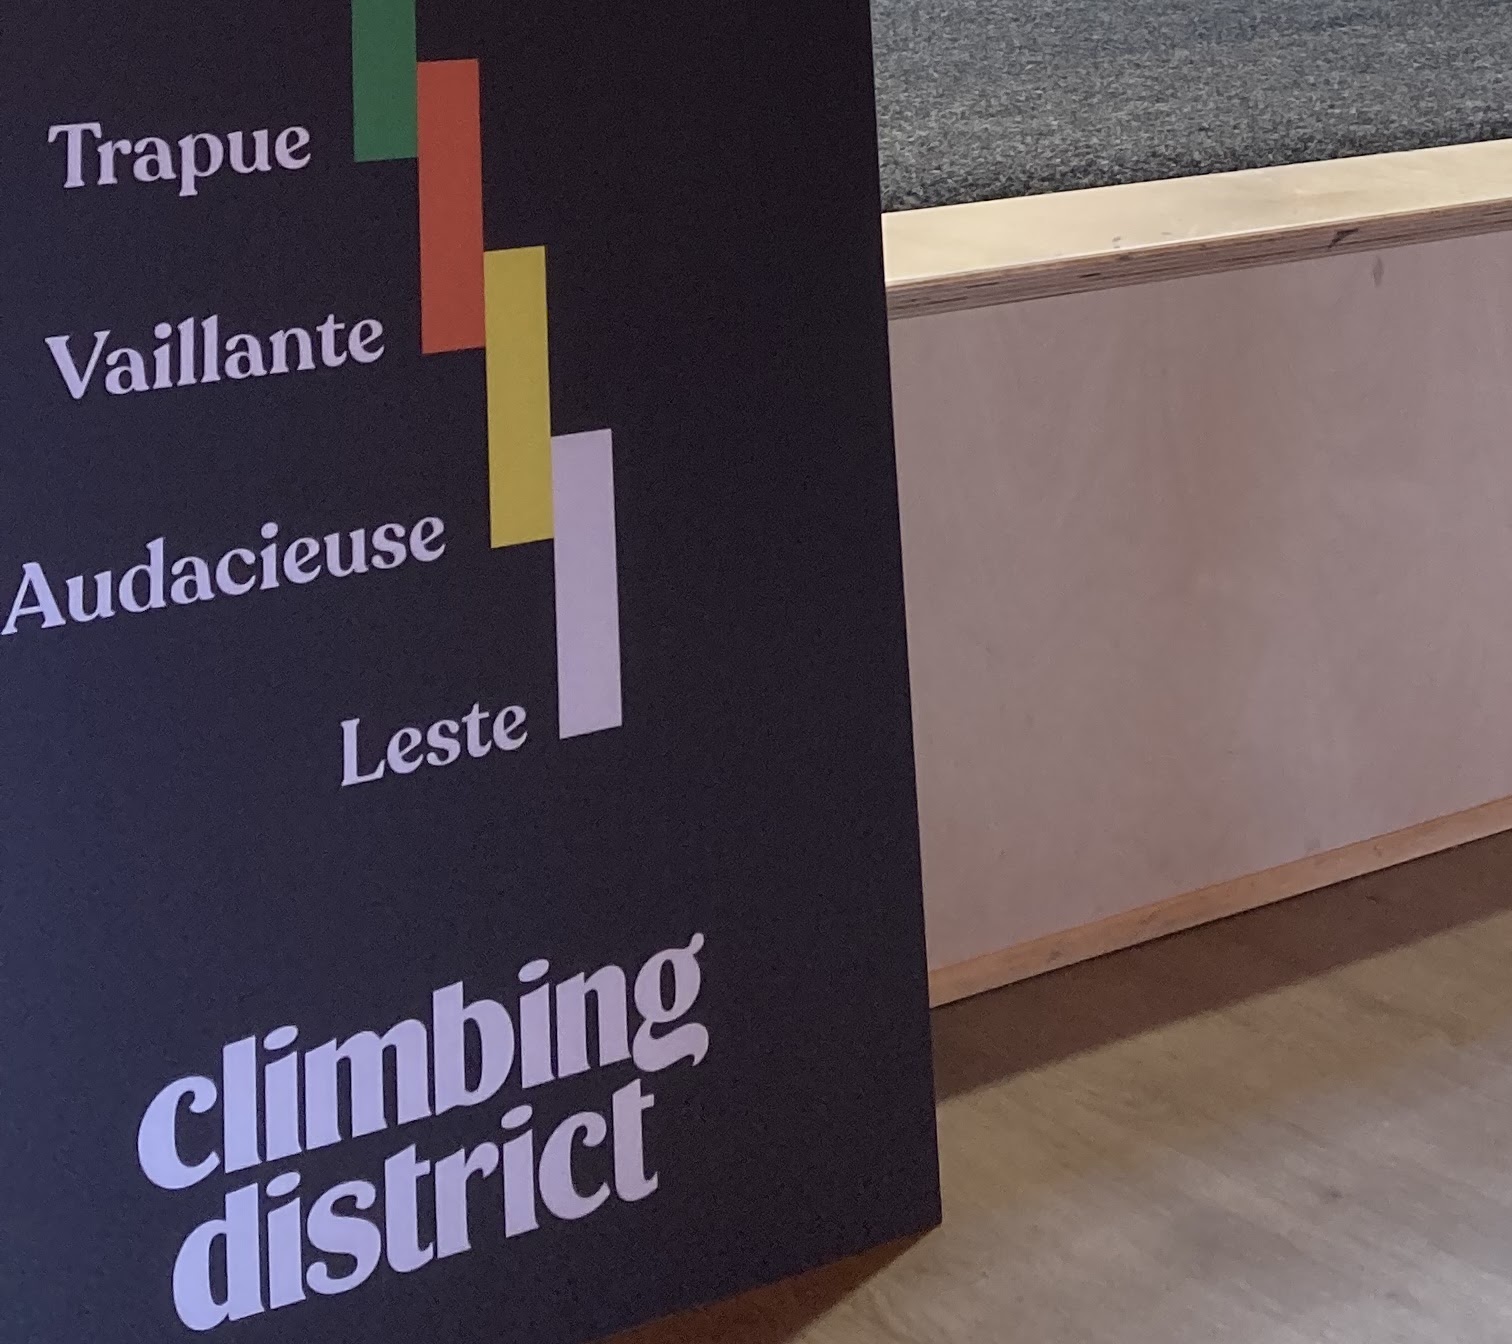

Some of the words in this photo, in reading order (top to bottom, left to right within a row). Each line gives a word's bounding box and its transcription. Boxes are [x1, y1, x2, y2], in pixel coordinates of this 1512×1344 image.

[47, 122, 312, 197] Trapue
[44, 313, 385, 400] Vaillante
[0, 516, 446, 636] Audacieuse
[340, 703, 528, 787] Leste
[137, 932, 710, 1191] climbing
[171, 1077, 660, 1332] district
